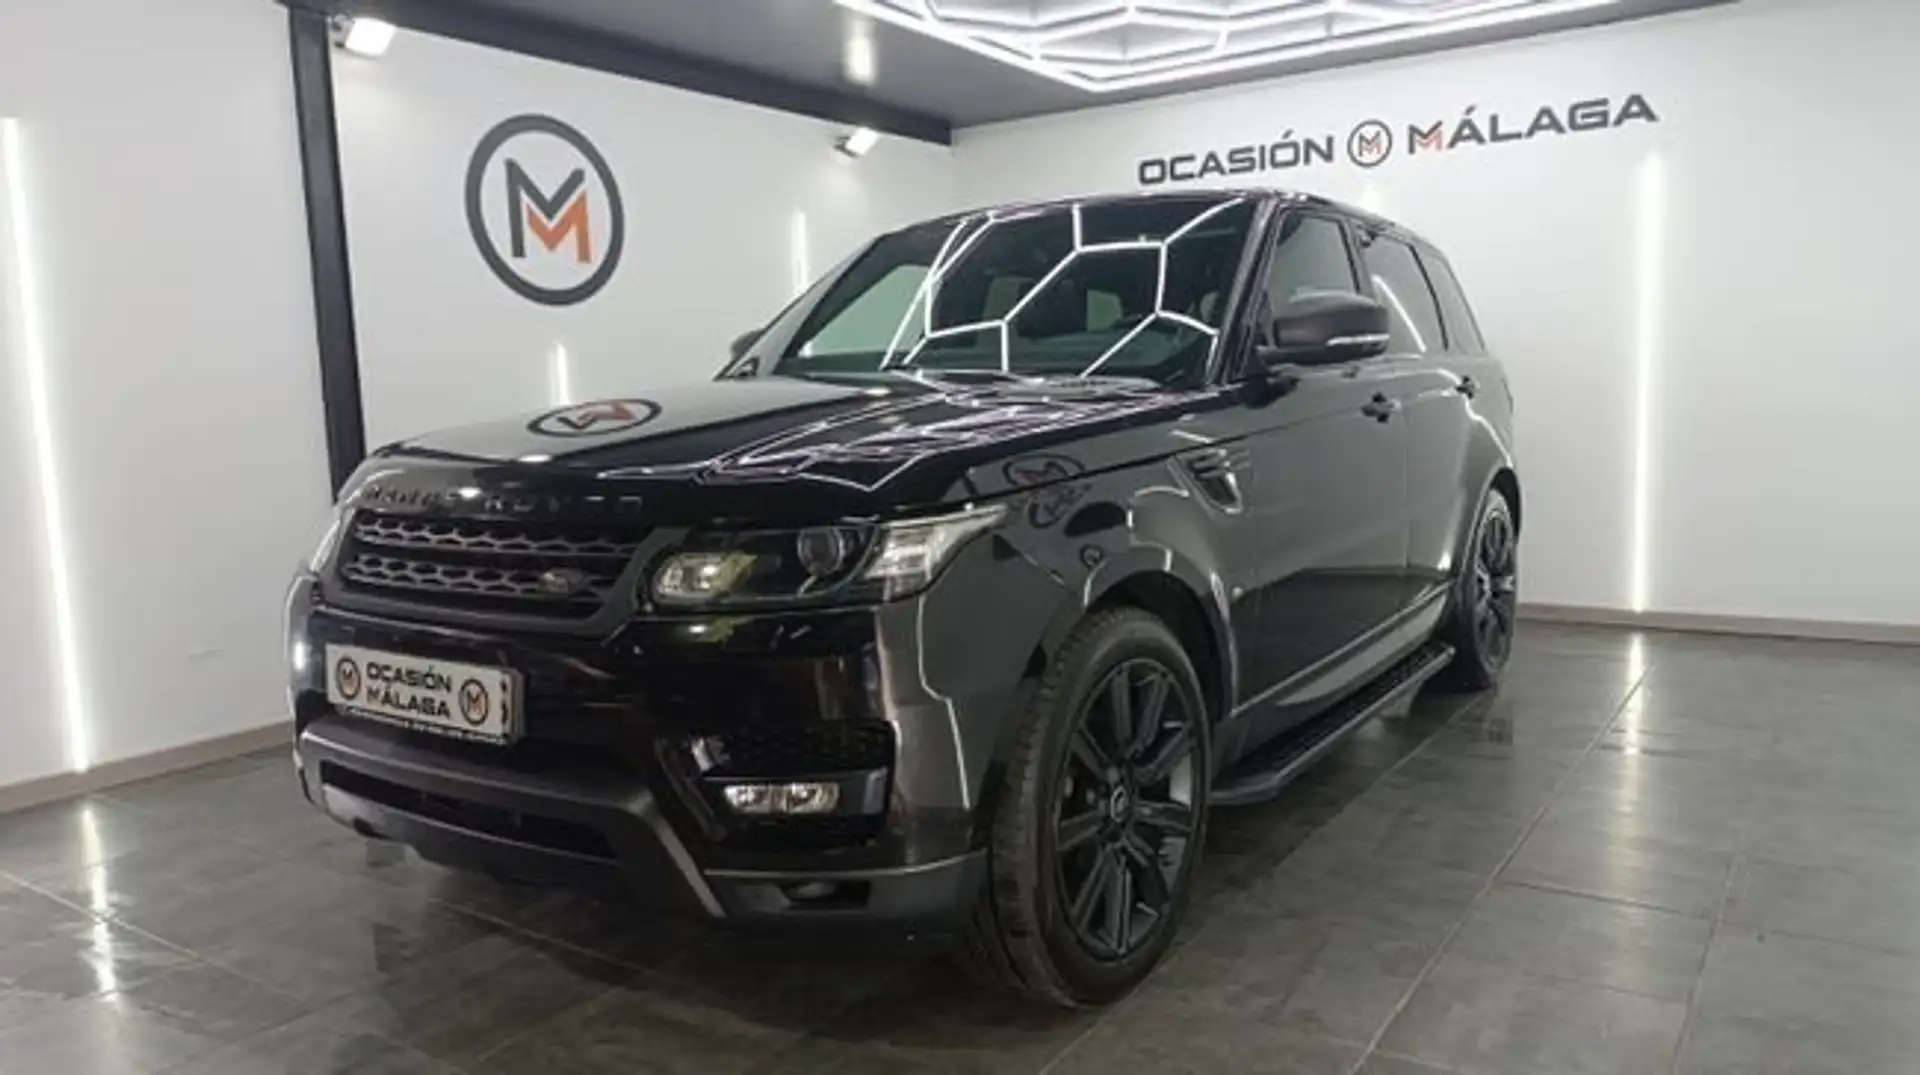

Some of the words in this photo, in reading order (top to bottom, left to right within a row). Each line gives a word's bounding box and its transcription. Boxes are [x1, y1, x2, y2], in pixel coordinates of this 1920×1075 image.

[1138, 128, 1334, 184] OCASIÓN
[1407, 94, 1658, 154] MÁLAGA
[366, 660, 452, 693] OCASIÓN
[366, 681, 451, 719] MÁLAGA
